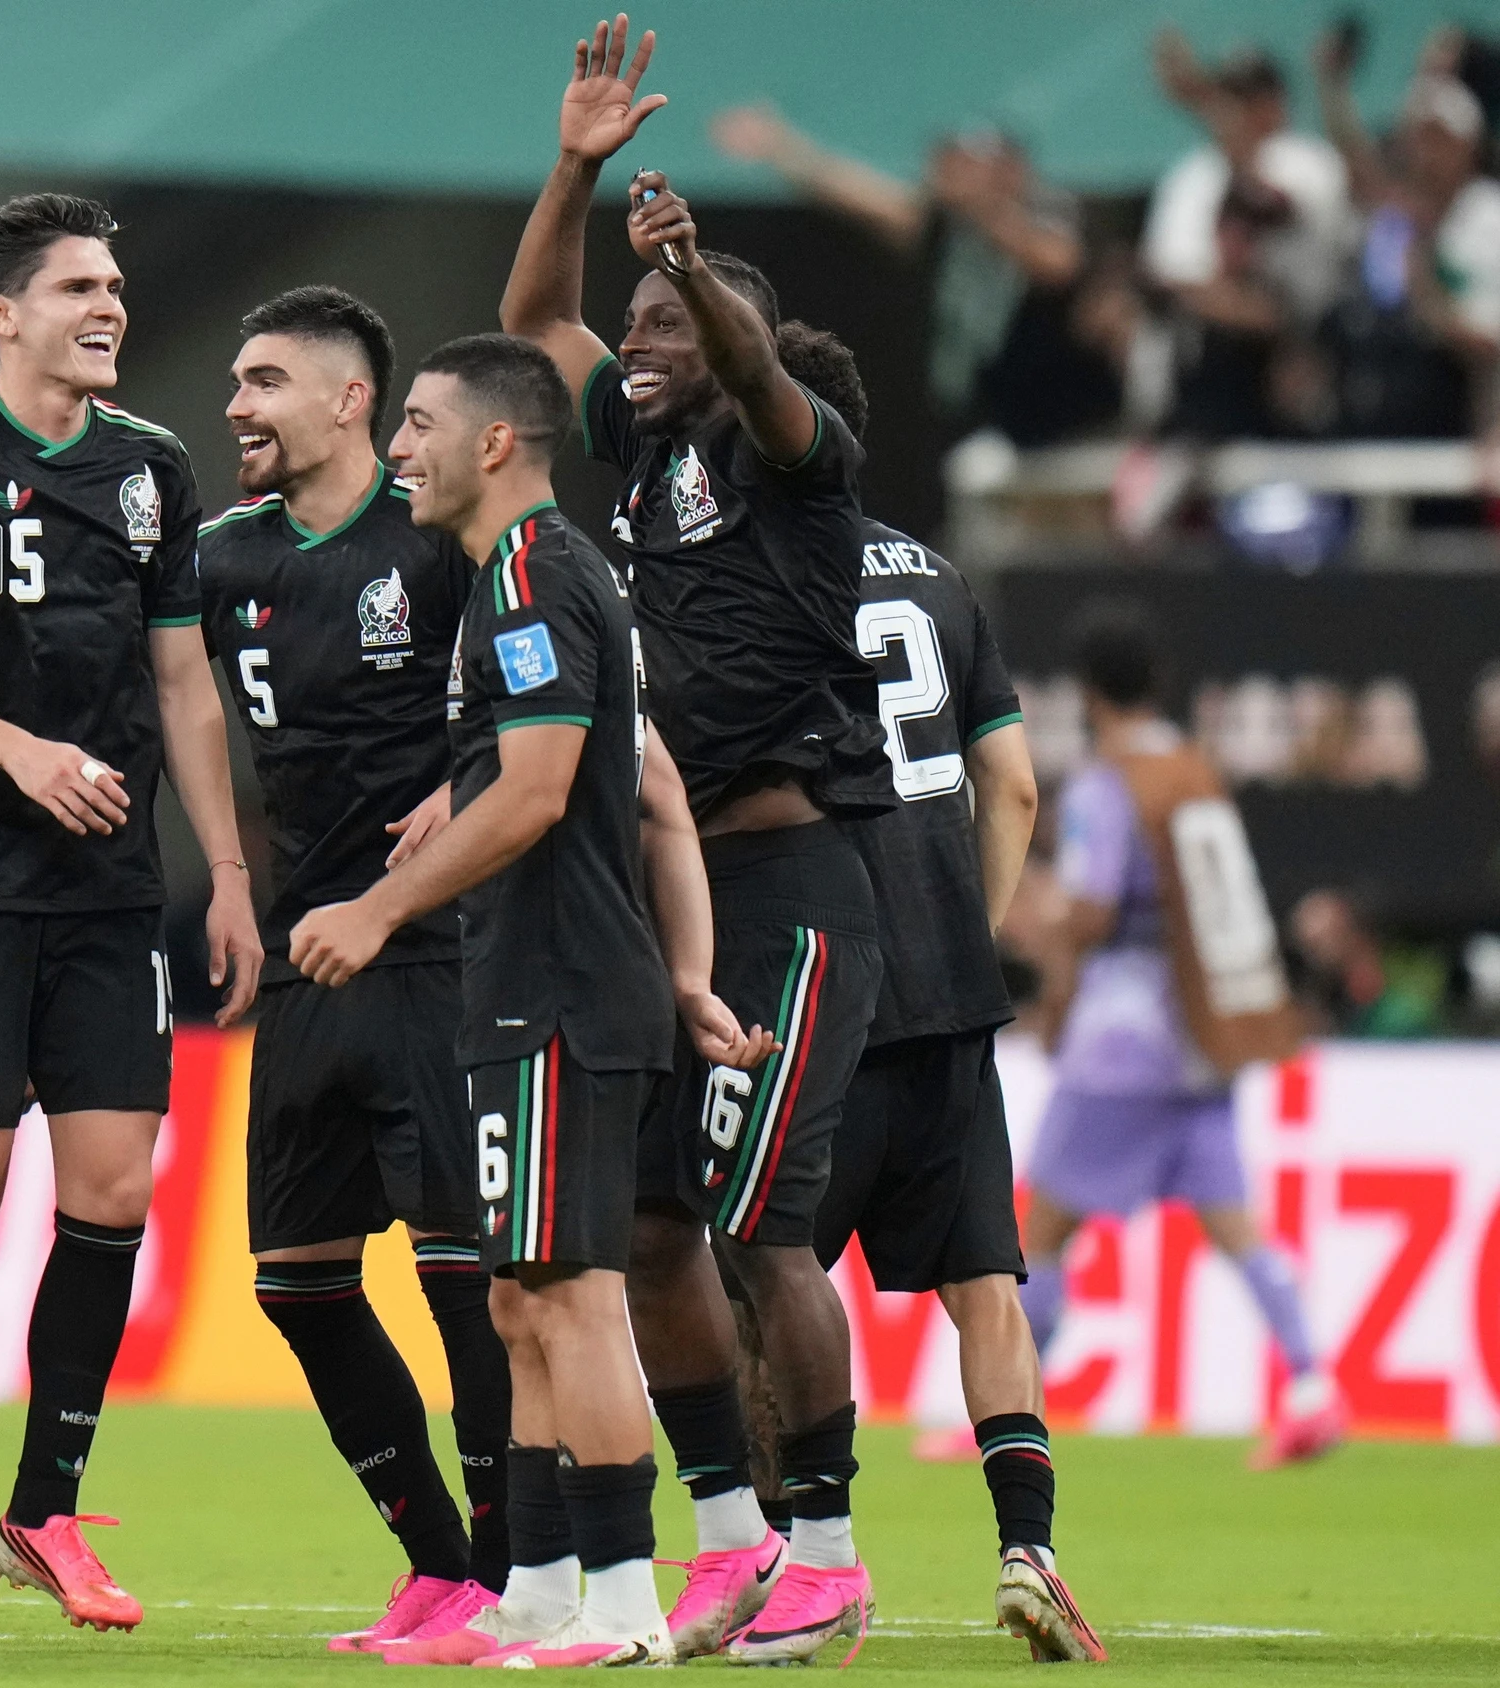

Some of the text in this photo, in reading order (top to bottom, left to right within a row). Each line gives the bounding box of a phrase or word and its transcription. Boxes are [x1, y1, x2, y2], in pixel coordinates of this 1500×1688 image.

[680, 502, 714, 528] MÉXICO
[131, 524, 160, 537] MÉXICO
[363, 631, 407, 644] MÉXICO
[238, 648, 279, 728] 5
[855, 600, 966, 802] 2
[151, 949, 173, 1037] 1
[478, 1112, 509, 1201] 6
[60, 1409, 99, 1426] MÉXI
[351, 1446, 397, 1474] ÉXICO
